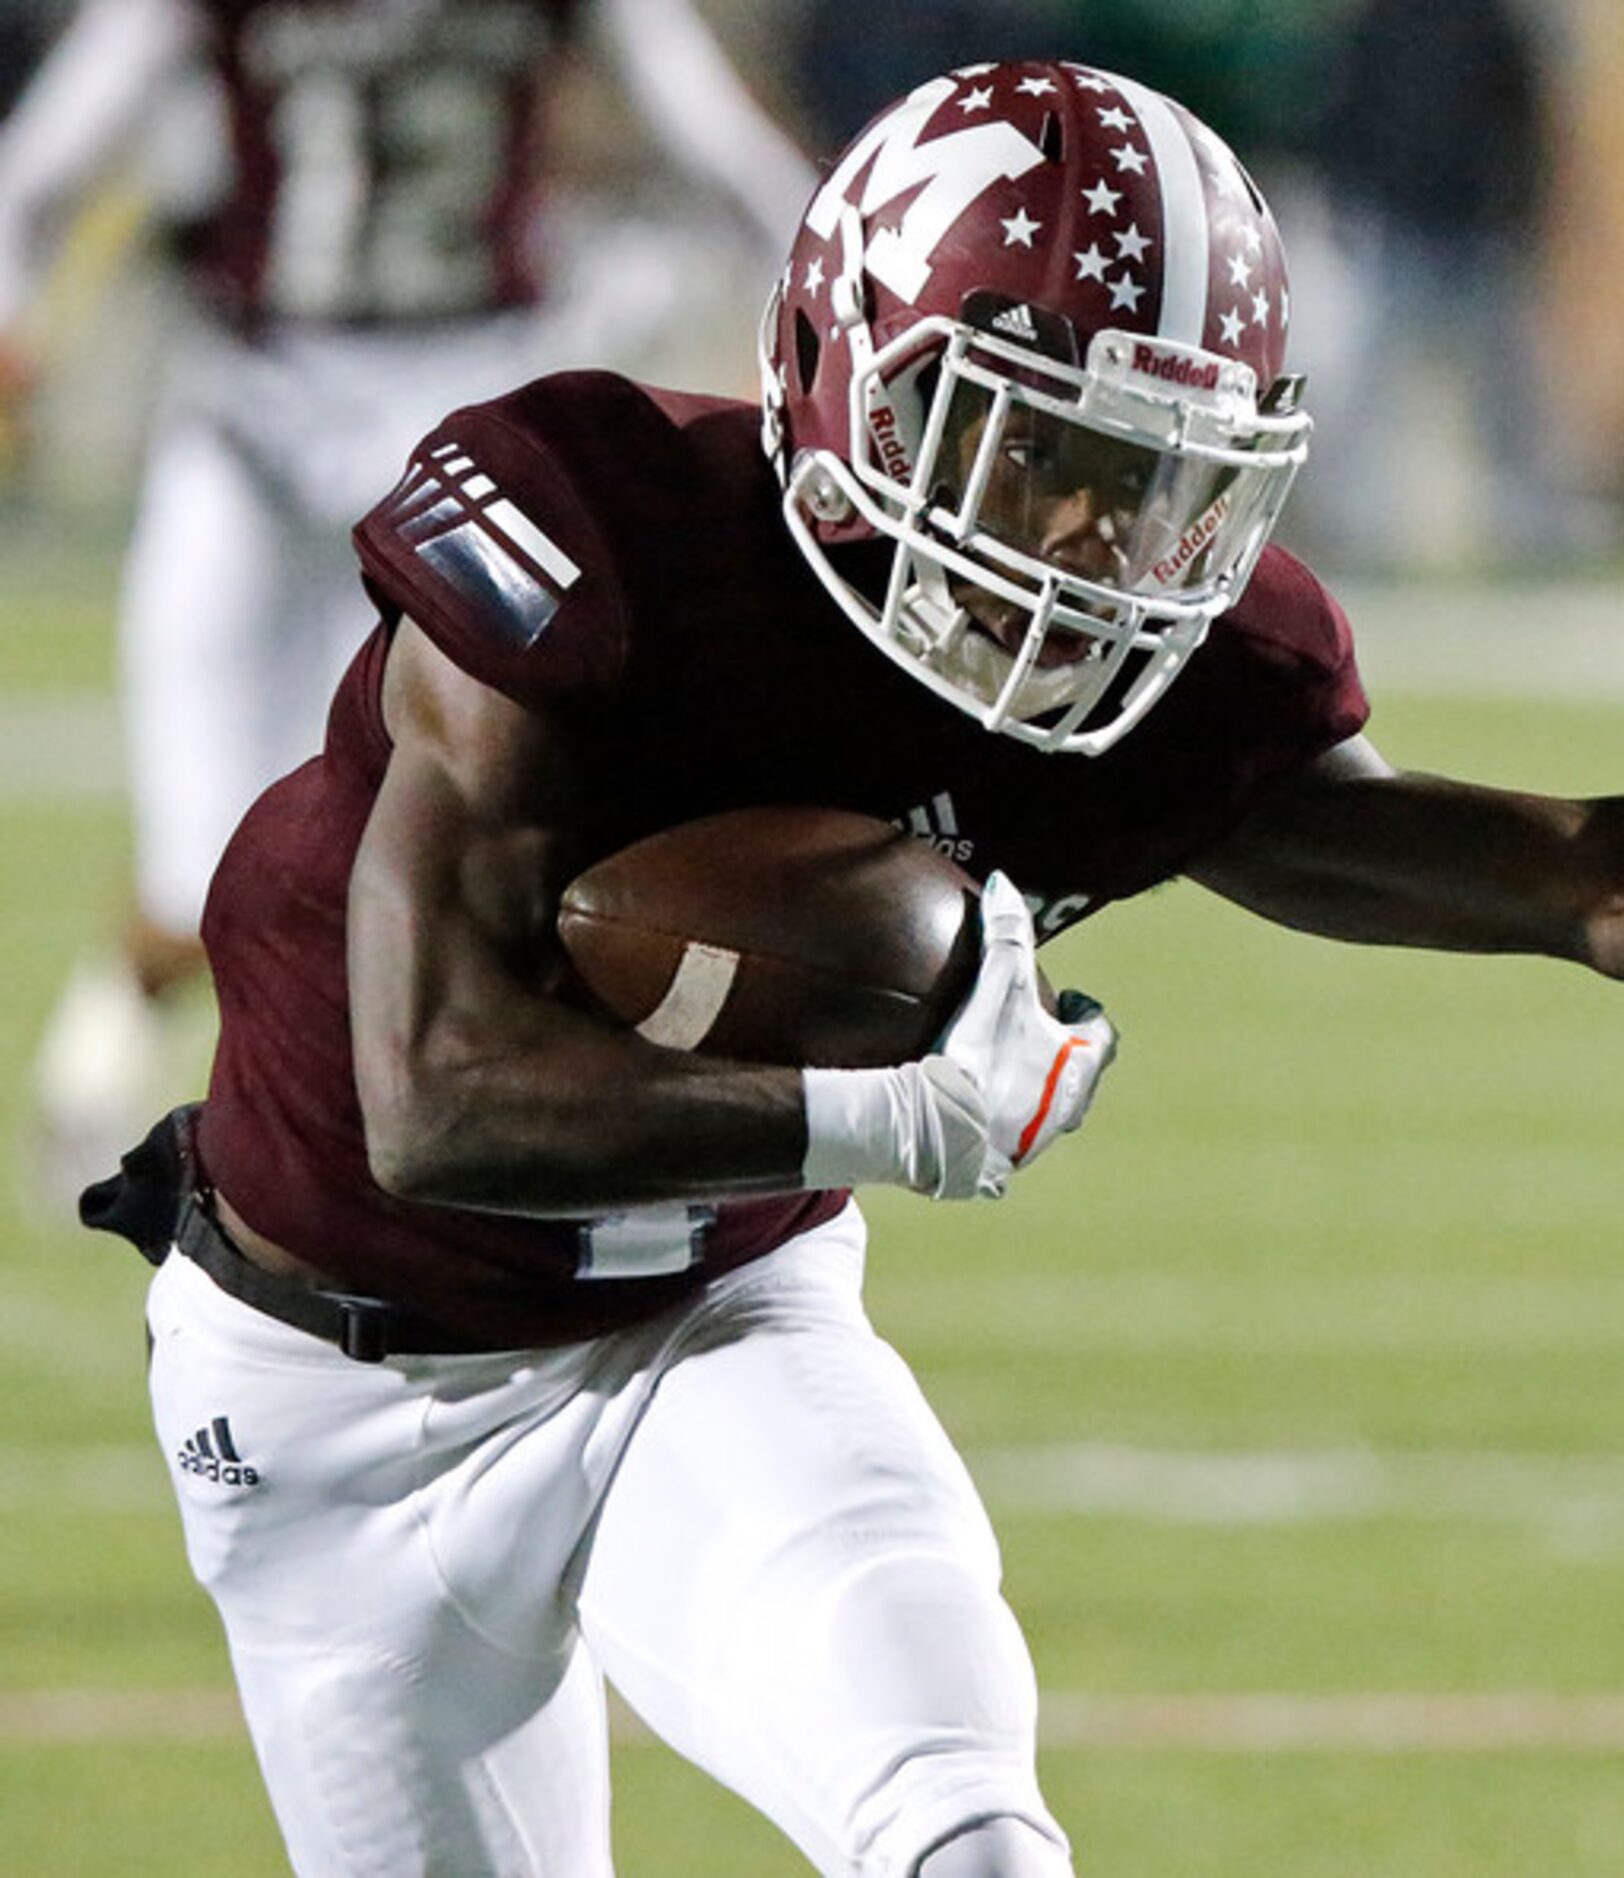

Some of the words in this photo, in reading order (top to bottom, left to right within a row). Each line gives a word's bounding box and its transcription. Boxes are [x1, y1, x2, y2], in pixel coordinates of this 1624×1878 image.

[805, 76, 1047, 306] M
[1132, 342, 1220, 391] Riddell
[1152, 496, 1228, 586] Riddell
